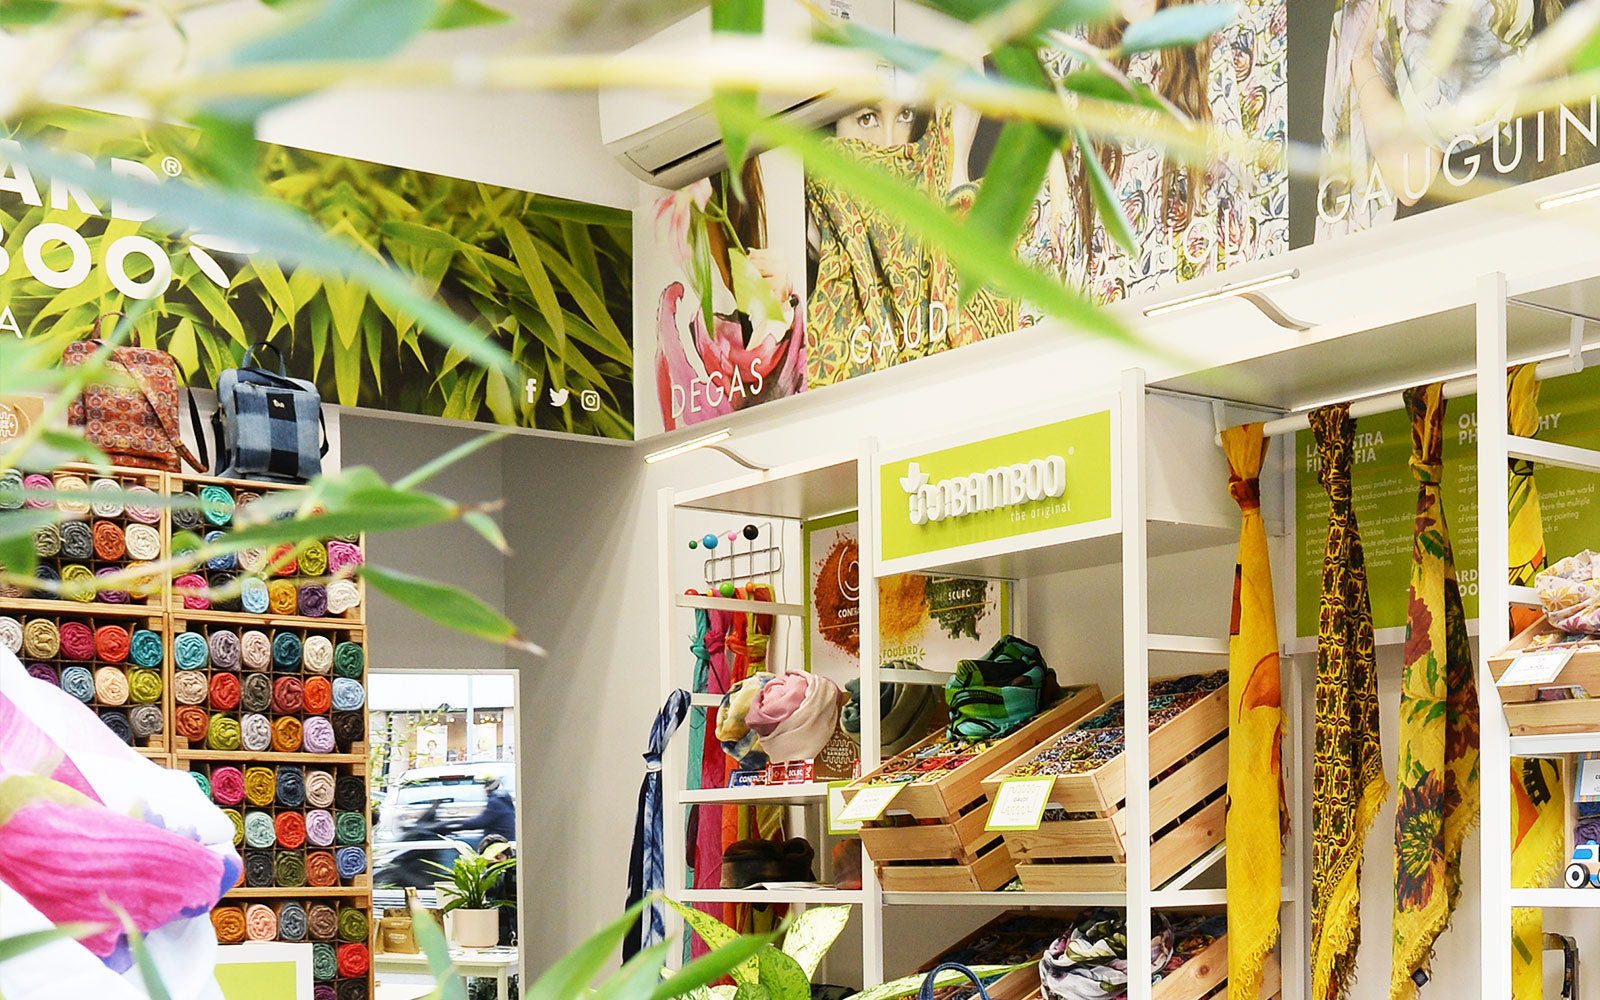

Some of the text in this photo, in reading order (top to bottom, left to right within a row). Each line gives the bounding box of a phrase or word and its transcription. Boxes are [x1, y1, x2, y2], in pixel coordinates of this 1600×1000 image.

[1316, 95, 1598, 224] GAUGUIN
[851, 294, 961, 364] GAUDI
[671, 357, 764, 420] DEGAS
[1458, 412, 1478, 429] OU
[1010, 499, 1071, 523] the original
[882, 645, 919, 659] FOULARD
